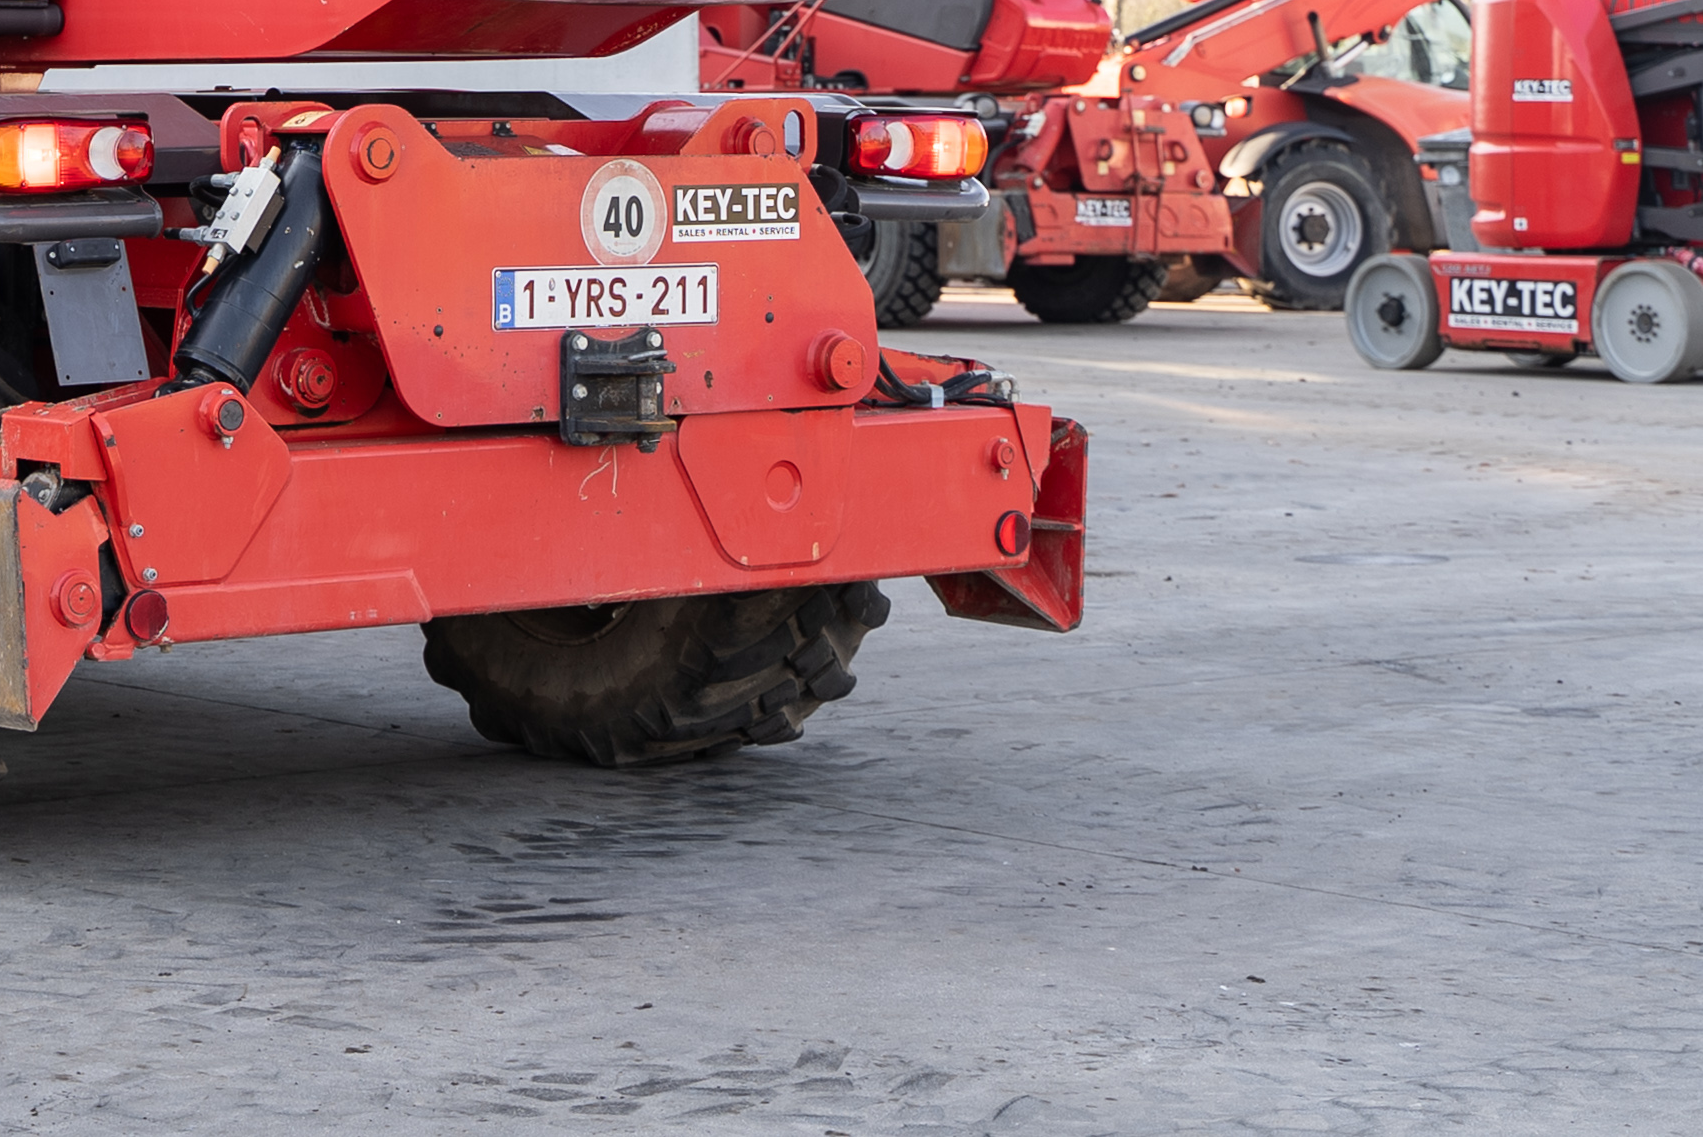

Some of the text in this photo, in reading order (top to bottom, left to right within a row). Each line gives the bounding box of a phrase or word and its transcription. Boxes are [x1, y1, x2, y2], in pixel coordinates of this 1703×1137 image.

[603, 195, 645, 238] 40
[676, 186, 797, 222] KEY-TEC
[678, 226, 796, 238] SALES RENTAL SERVICE
[498, 303, 512, 324] B
[523, 275, 709, 320] 1-YRS-211
[1451, 278, 1575, 318] KEY-TEC
